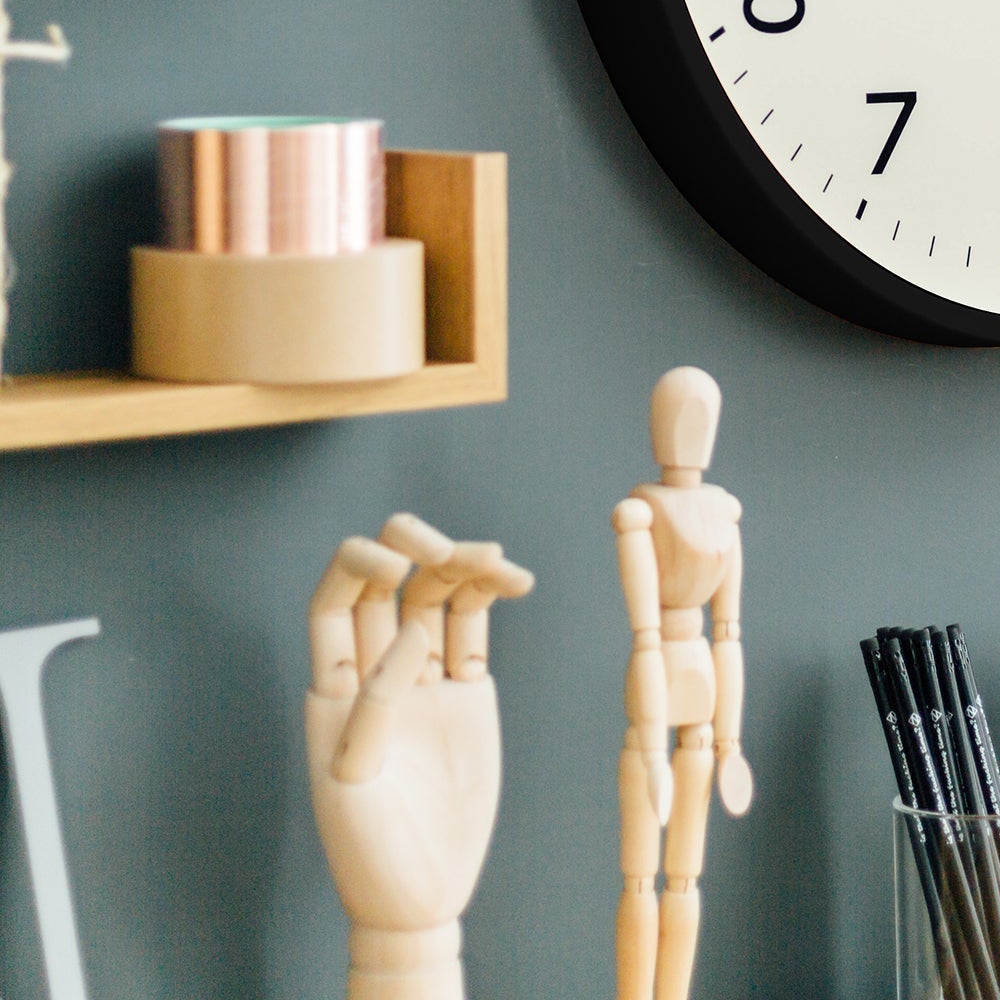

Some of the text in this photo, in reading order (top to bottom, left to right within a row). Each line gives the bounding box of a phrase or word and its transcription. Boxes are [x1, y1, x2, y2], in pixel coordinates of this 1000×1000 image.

[865, 91, 918, 175] 7
[925, 753, 940, 793] fucking
[979, 745, 993, 785] fucking
